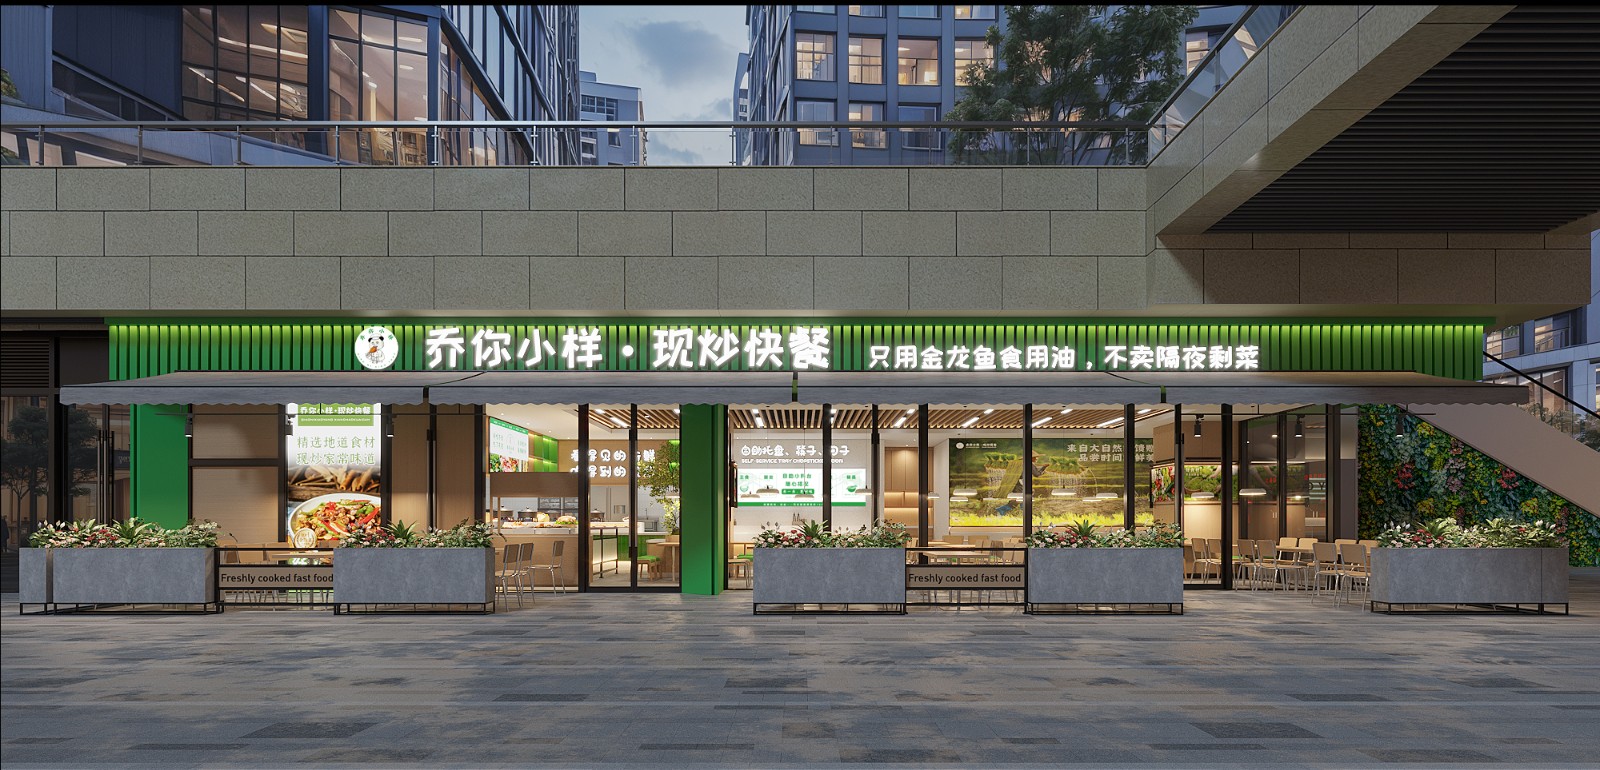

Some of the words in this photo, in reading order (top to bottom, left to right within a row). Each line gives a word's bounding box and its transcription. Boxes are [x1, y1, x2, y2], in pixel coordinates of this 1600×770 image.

[868, 344, 1260, 370] 只用金龙鱼食用油，不卖隔夜剩菜
[297, 436, 376, 449] 精选地道食材
[296, 452, 376, 465] 现炒家常味道
[221, 573, 255, 584] Freshly
[258, 573, 291, 582] cooked
[293, 573, 311, 582] fast
[313, 573, 334, 582] food
[908, 573, 943, 584] Freshly
[945, 573, 979, 582] cooked
[980, 573, 998, 582] fast
[1001, 573, 1021, 582] food
